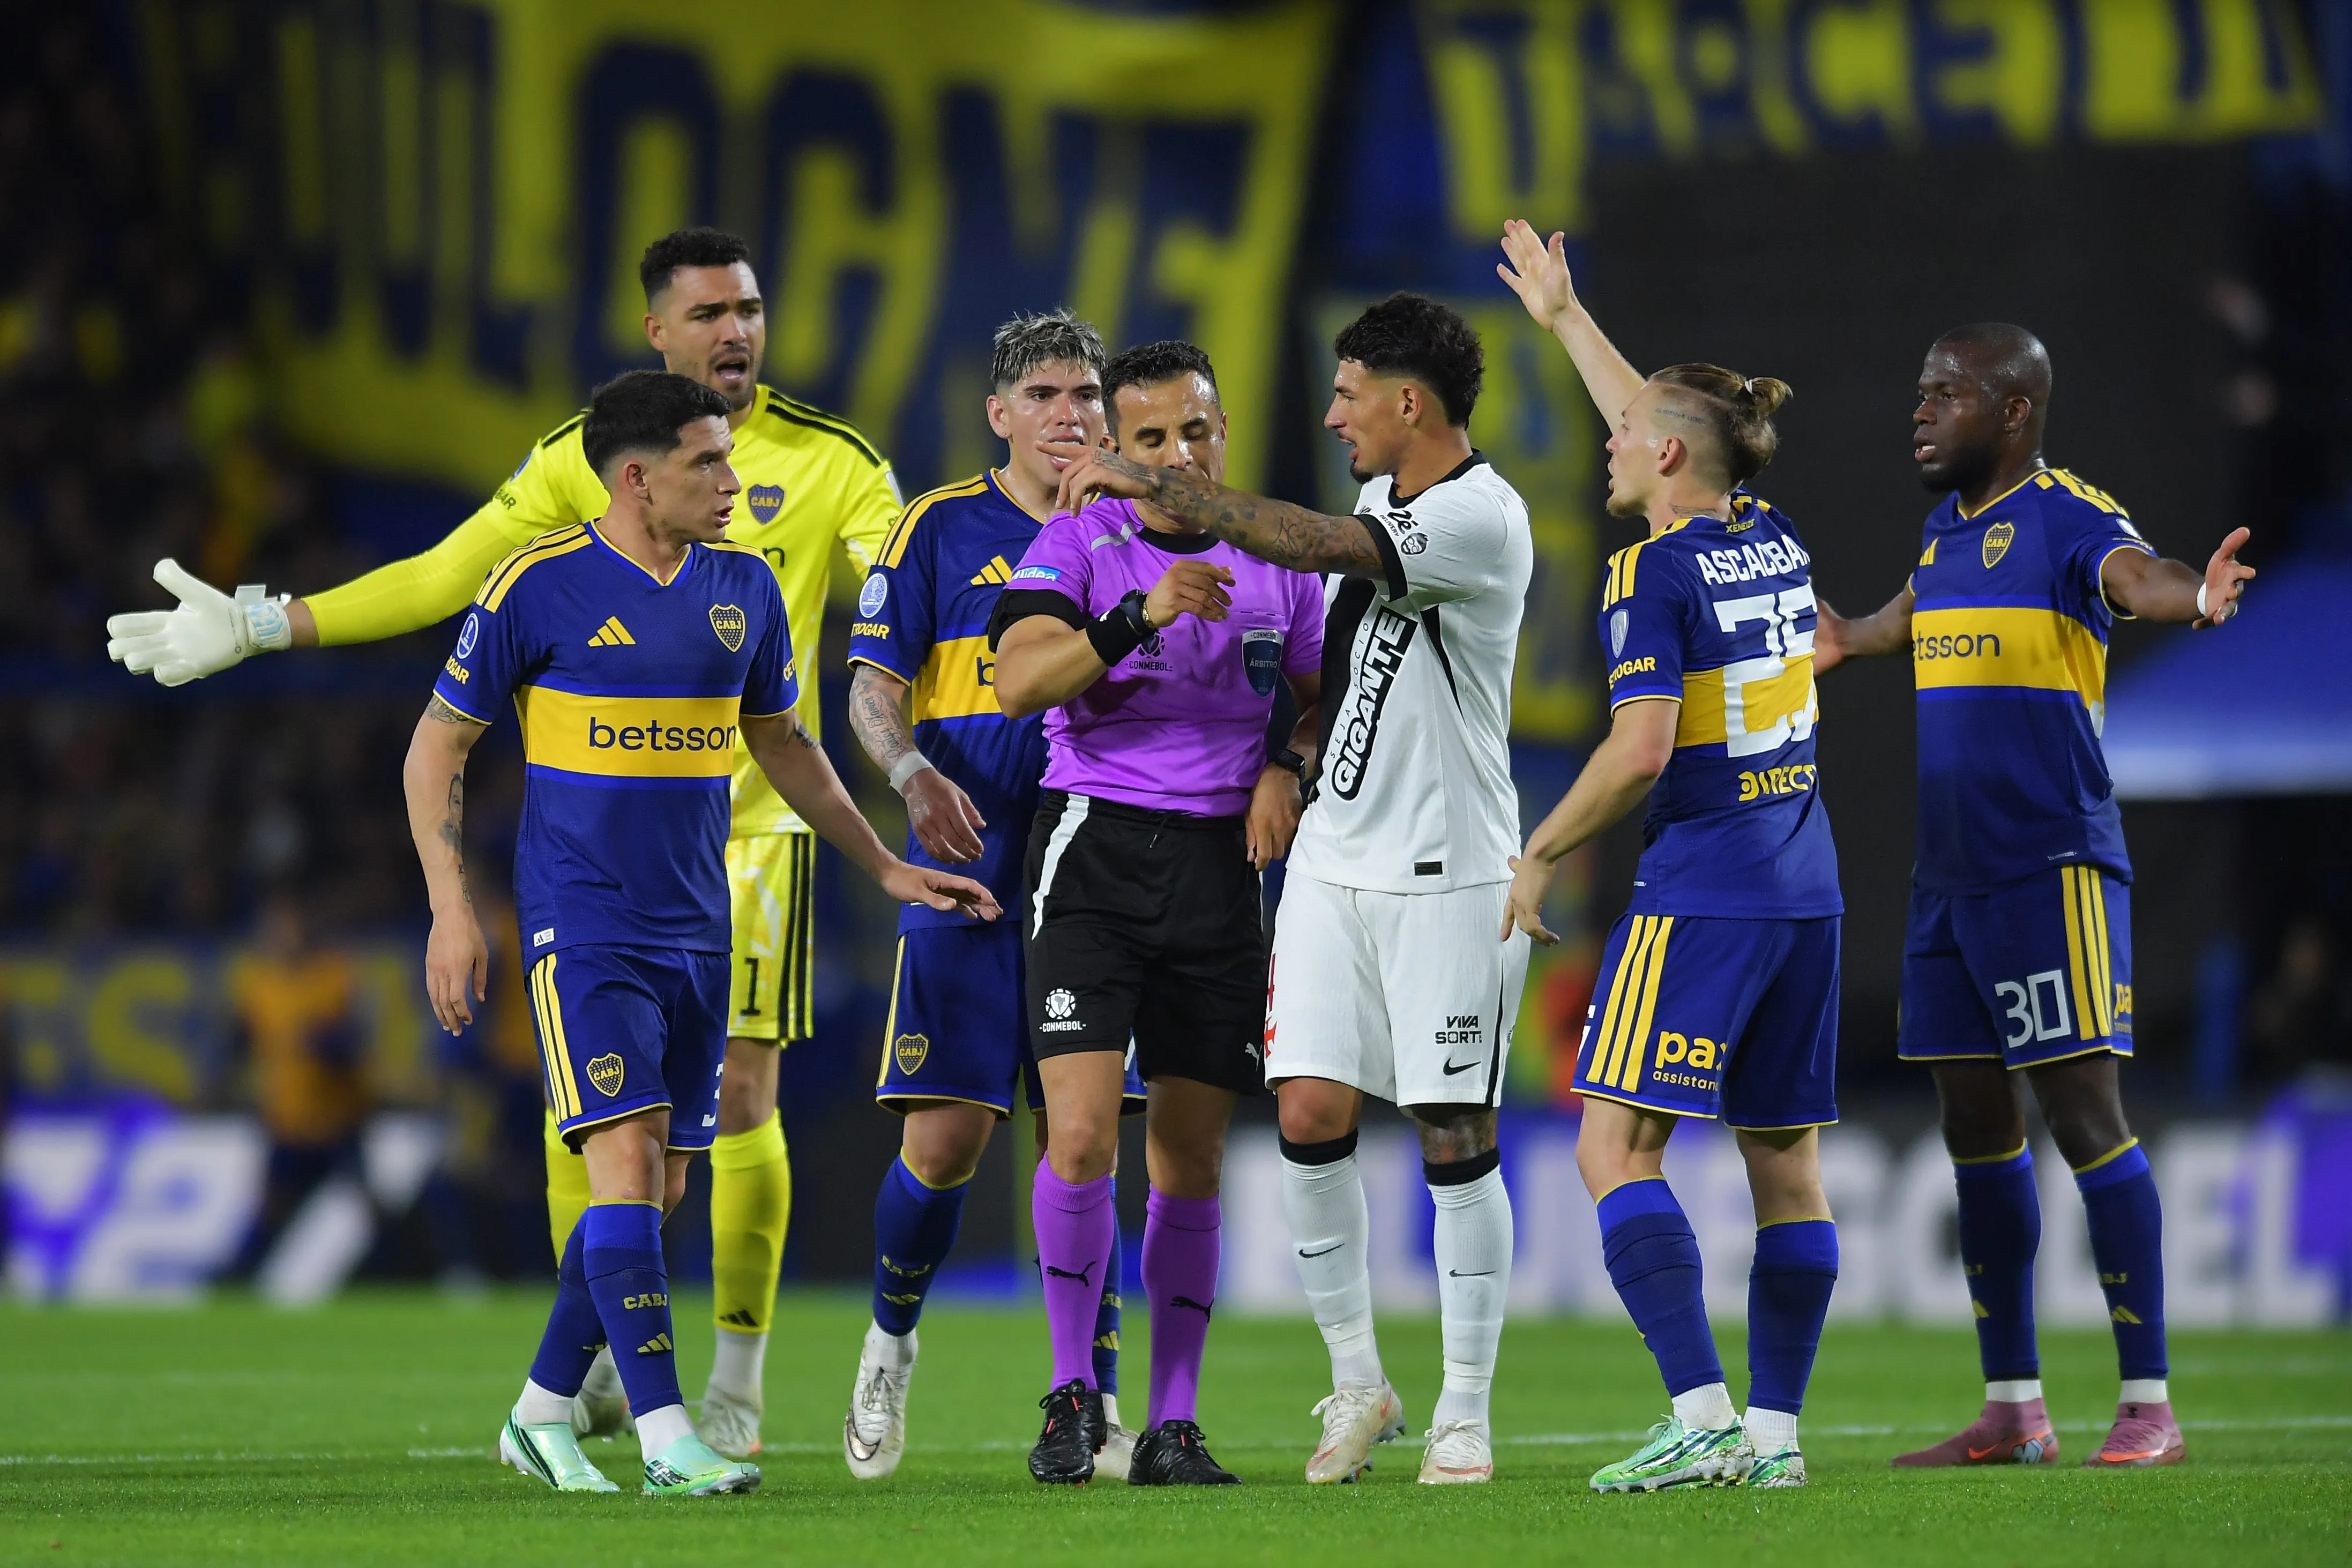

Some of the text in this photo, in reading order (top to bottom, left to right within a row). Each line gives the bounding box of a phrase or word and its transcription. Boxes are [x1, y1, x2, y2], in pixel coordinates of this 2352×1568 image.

[751, 496, 780, 507] CABJ
[1379, 514, 1400, 536] DELIVERY
[1386, 510, 1419, 535] Zé
[1986, 538, 2008, 547] CABJ
[716, 620, 742, 630] CABJ
[1913, 630, 2000, 661] tsson
[1249, 658, 1278, 669] ÁRBITRO
[1330, 623, 1369, 759] SEJA SOCIO
[1334, 611, 1407, 793] GIGANTE
[589, 716, 736, 751] betsson
[1995, 969, 2071, 1048] 30
[1445, 1015, 1479, 1029] VIVA
[899, 1048, 923, 1056] CABJ
[593, 1066, 620, 1081] CABJ
[623, 1293, 667, 1310] CABJ
